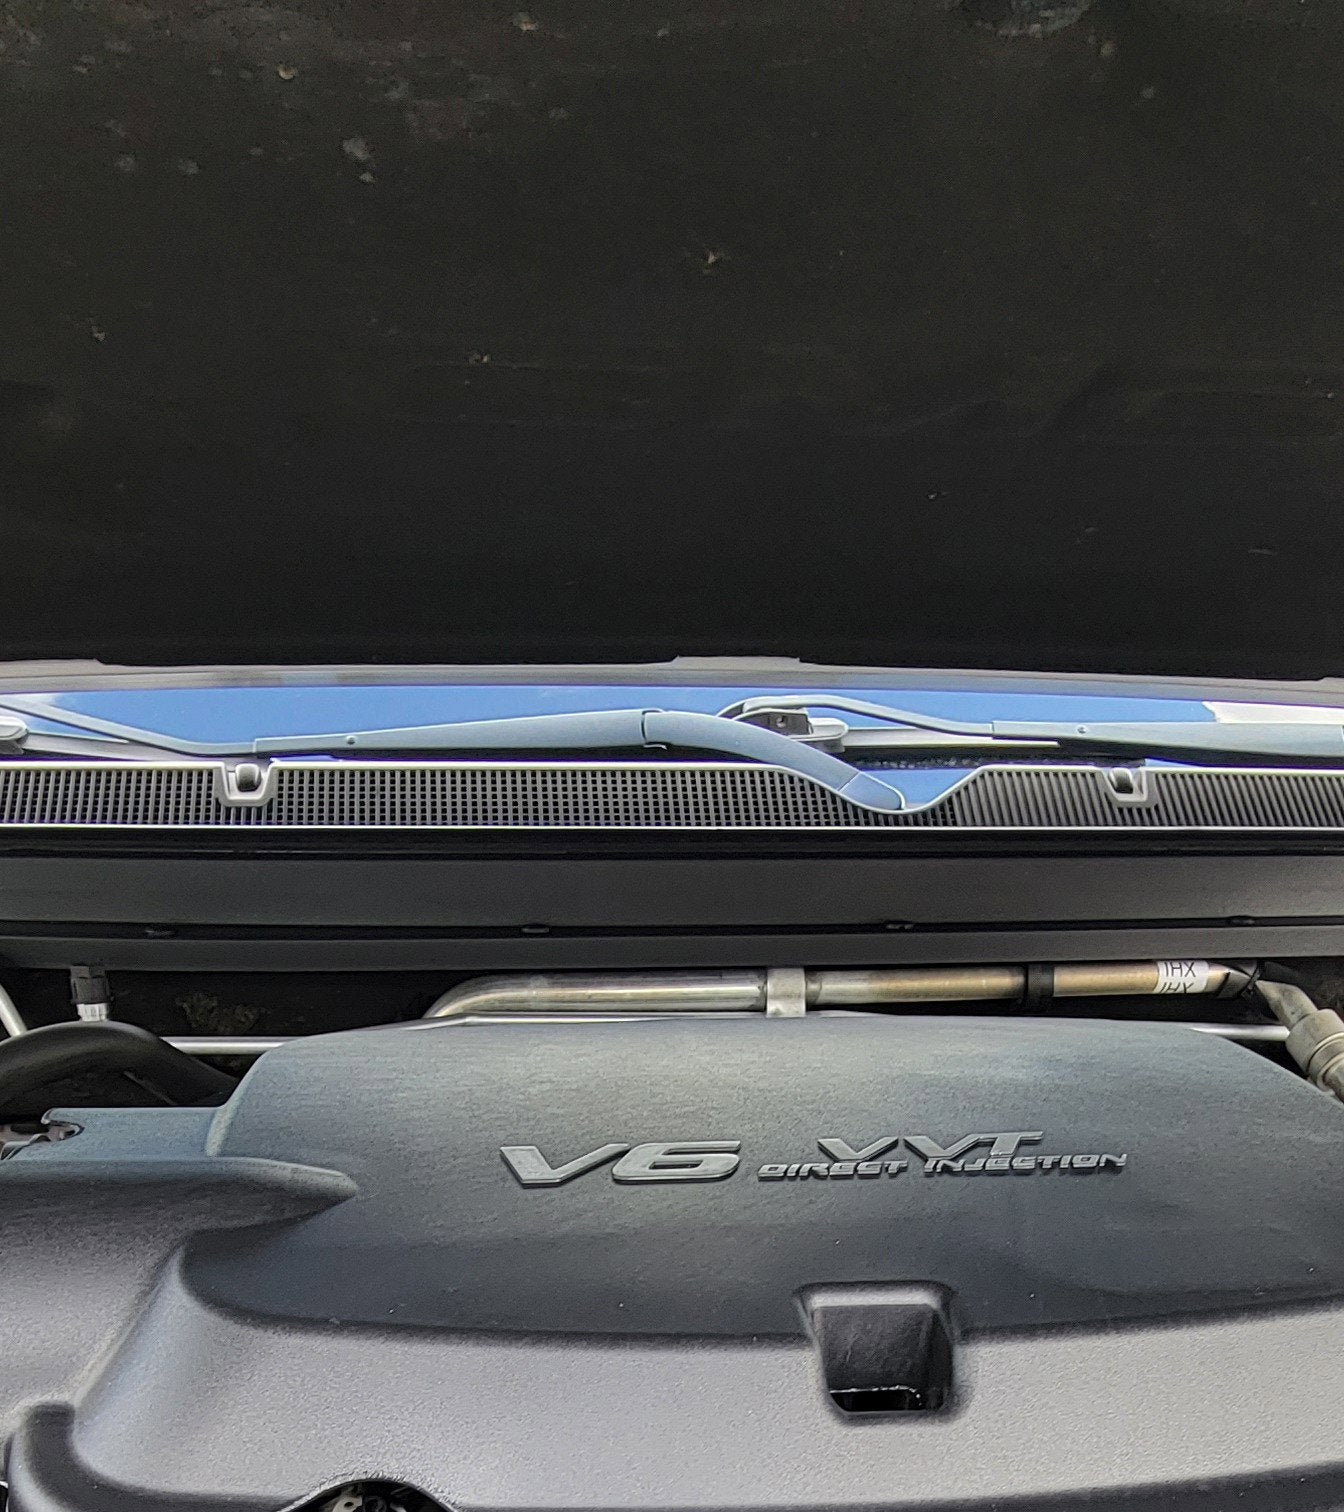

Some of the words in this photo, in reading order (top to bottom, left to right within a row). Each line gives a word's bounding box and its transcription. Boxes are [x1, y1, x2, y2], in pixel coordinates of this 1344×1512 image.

[1164, 961, 1196, 978] IHX
[499, 1140, 741, 1187] V6
[818, 1131, 1044, 1165] VVT
[757, 1159, 909, 1180] DIRECT
[923, 1152, 1129, 1175] INJECTION
